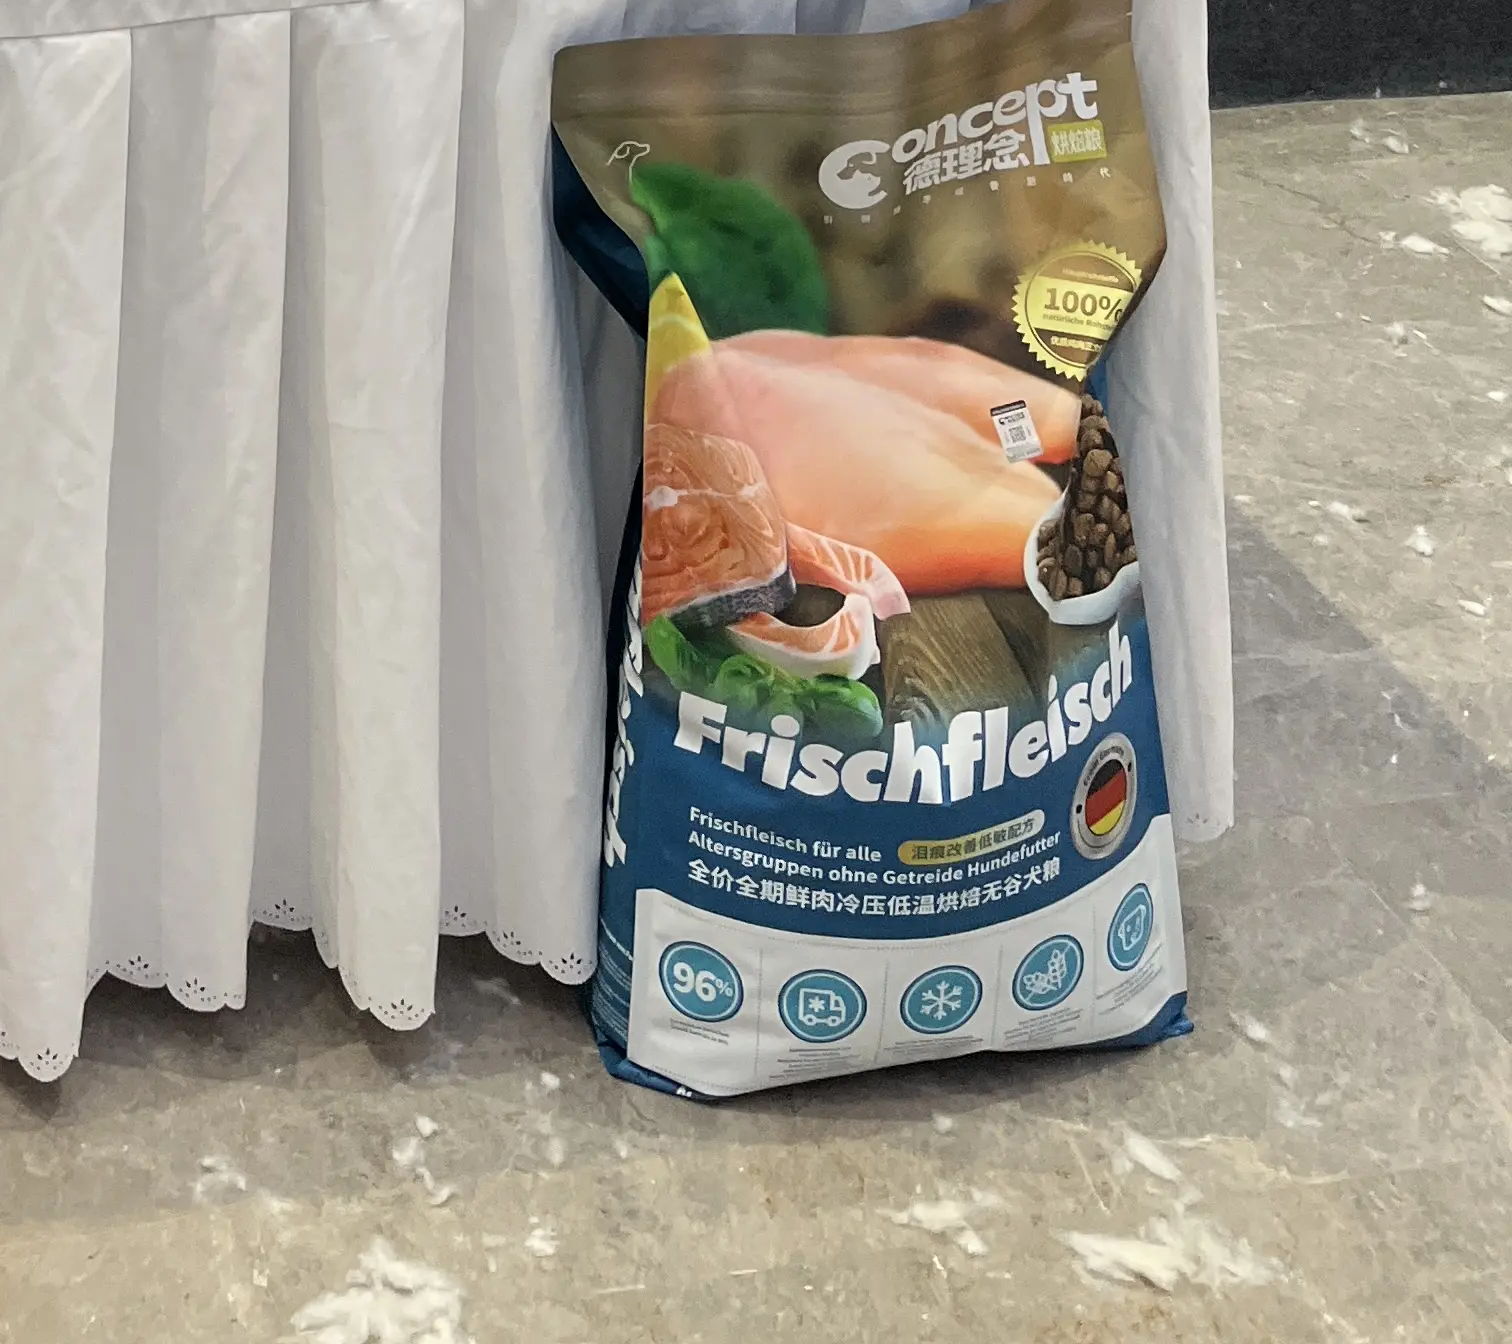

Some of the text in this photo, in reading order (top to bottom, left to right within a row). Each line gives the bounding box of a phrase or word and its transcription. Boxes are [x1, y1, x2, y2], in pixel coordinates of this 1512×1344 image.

[818, 71, 1099, 210] Concept
[902, 127, 1028, 197] 德理念
[673, 624, 1132, 805] Frischfleisch
[688, 830, 1062, 886] Altersgruppen ohne Getreide Hundefutter
[689, 806, 882, 863] Frischfleisch für alle
[687, 857, 1061, 917] 全价全期鲜肉冷压低温烘焙无谷犬粮
[672, 961, 734, 1003] 96%
